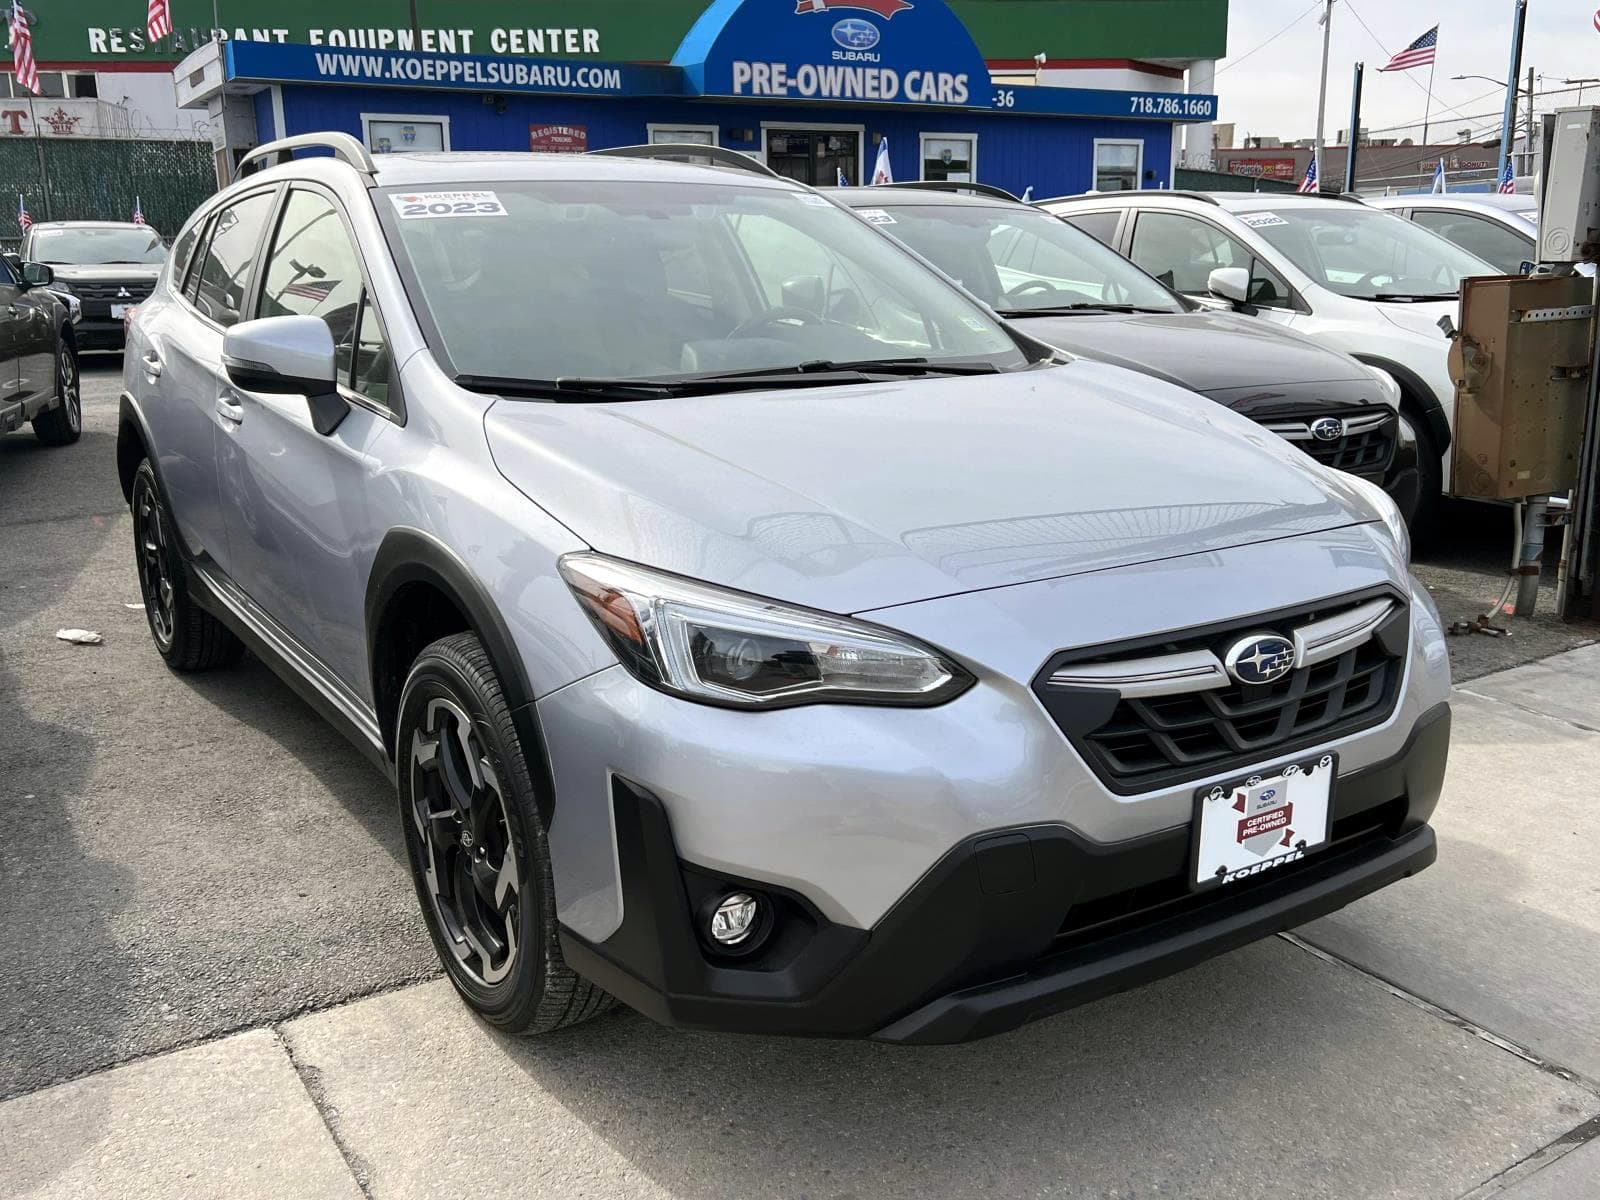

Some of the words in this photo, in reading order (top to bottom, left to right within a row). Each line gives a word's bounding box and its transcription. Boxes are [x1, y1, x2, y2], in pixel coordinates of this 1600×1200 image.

[490, 27, 600, 53] CENTER
[832, 51, 880, 62] SUBARU
[315, 52, 622, 90] WWW.KOEPPELSUBARU.COM
[732, 61, 900, 101] PRE-OWNED
[904, 71, 969, 104] CARS
[1130, 97, 1212, 116] 718.786.1660
[531, 126, 586, 139] REGISTERED
[1462, 161, 1489, 169] DONUTS
[403, 202, 501, 216] 2023
[1248, 217, 1283, 226] 2020
[1256, 799, 1278, 810] SUBARU
[1242, 817, 1287, 836] PRE-OWNED
[1247, 810, 1284, 827] CERTIFIED
[1222, 851, 1305, 884] KOEPPEL
